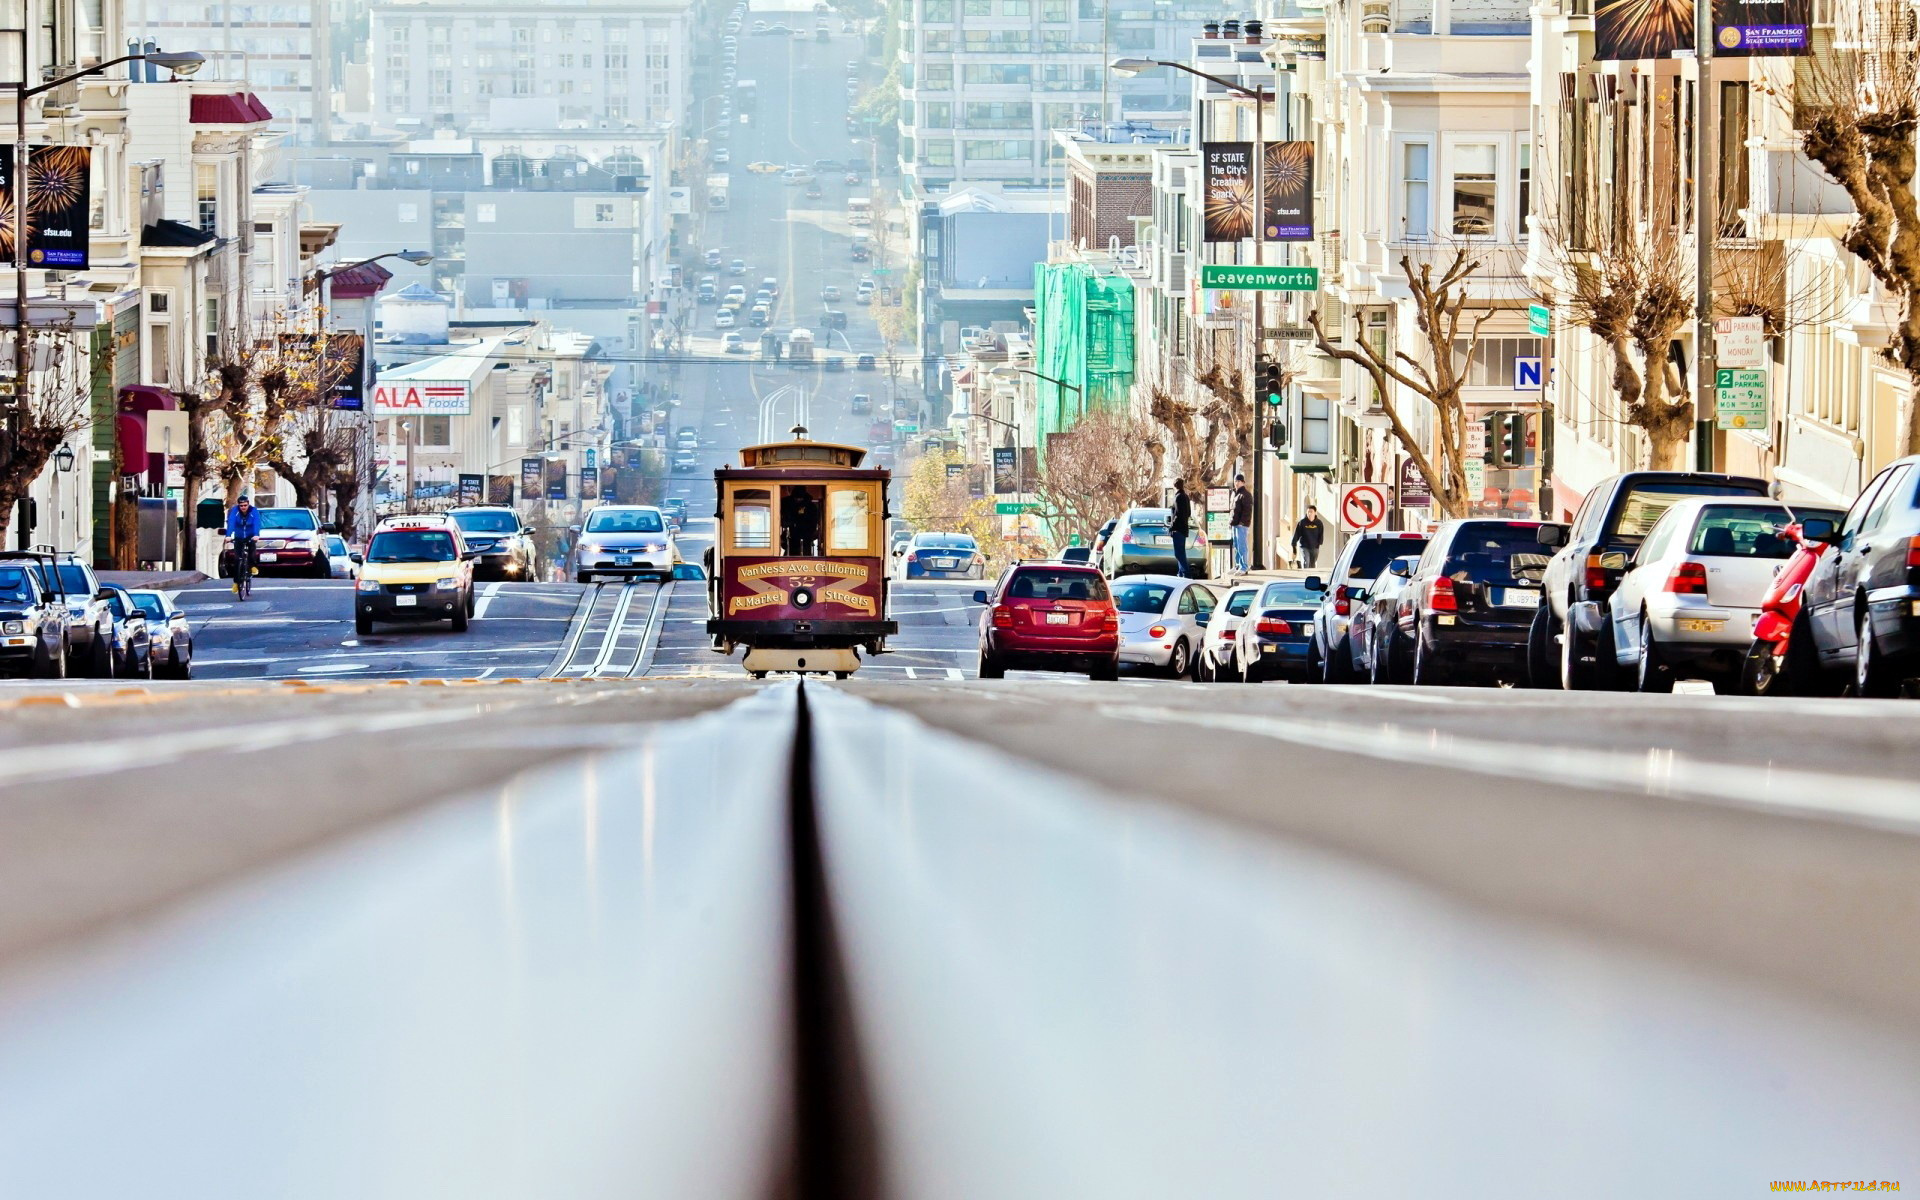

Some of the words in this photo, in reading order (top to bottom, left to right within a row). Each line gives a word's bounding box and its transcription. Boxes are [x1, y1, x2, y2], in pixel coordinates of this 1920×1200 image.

[1745, 28, 1761, 36] SAN
[1762, 28, 1803, 36] FRANCISCO
[1210, 153, 1220, 163] SF
[1222, 152, 1245, 163] STATE
[1210, 165, 1225, 175] The
[1226, 164, 1247, 176] City's
[1211, 177, 1244, 187] Creative
[1211, 189, 1234, 200] Spark
[1277, 207, 1300, 215] sfsu.edu
[43, 227, 72, 237] sfsu.edu
[1207, 270, 1313, 286] Leavenworth
[1718, 319, 1731, 333] NO
[1733, 322, 1761, 331] PARKING
[1265, 329, 1313, 339] LEAVENWORTH
[1727, 347, 1754, 356] MONDAY
[1720, 372, 1730, 385] 2
[427, 396, 465, 408] Foods
[1465, 425, 1483, 433] ARKING
[740, 566, 760, 577] Van
[759, 563, 785, 575] Ness
[814, 562, 867, 577] California
[788, 576, 816, 588] 52
[735, 597, 743, 607] &
[744, 592, 784, 608] Market
[825, 590, 869, 607] Streets
